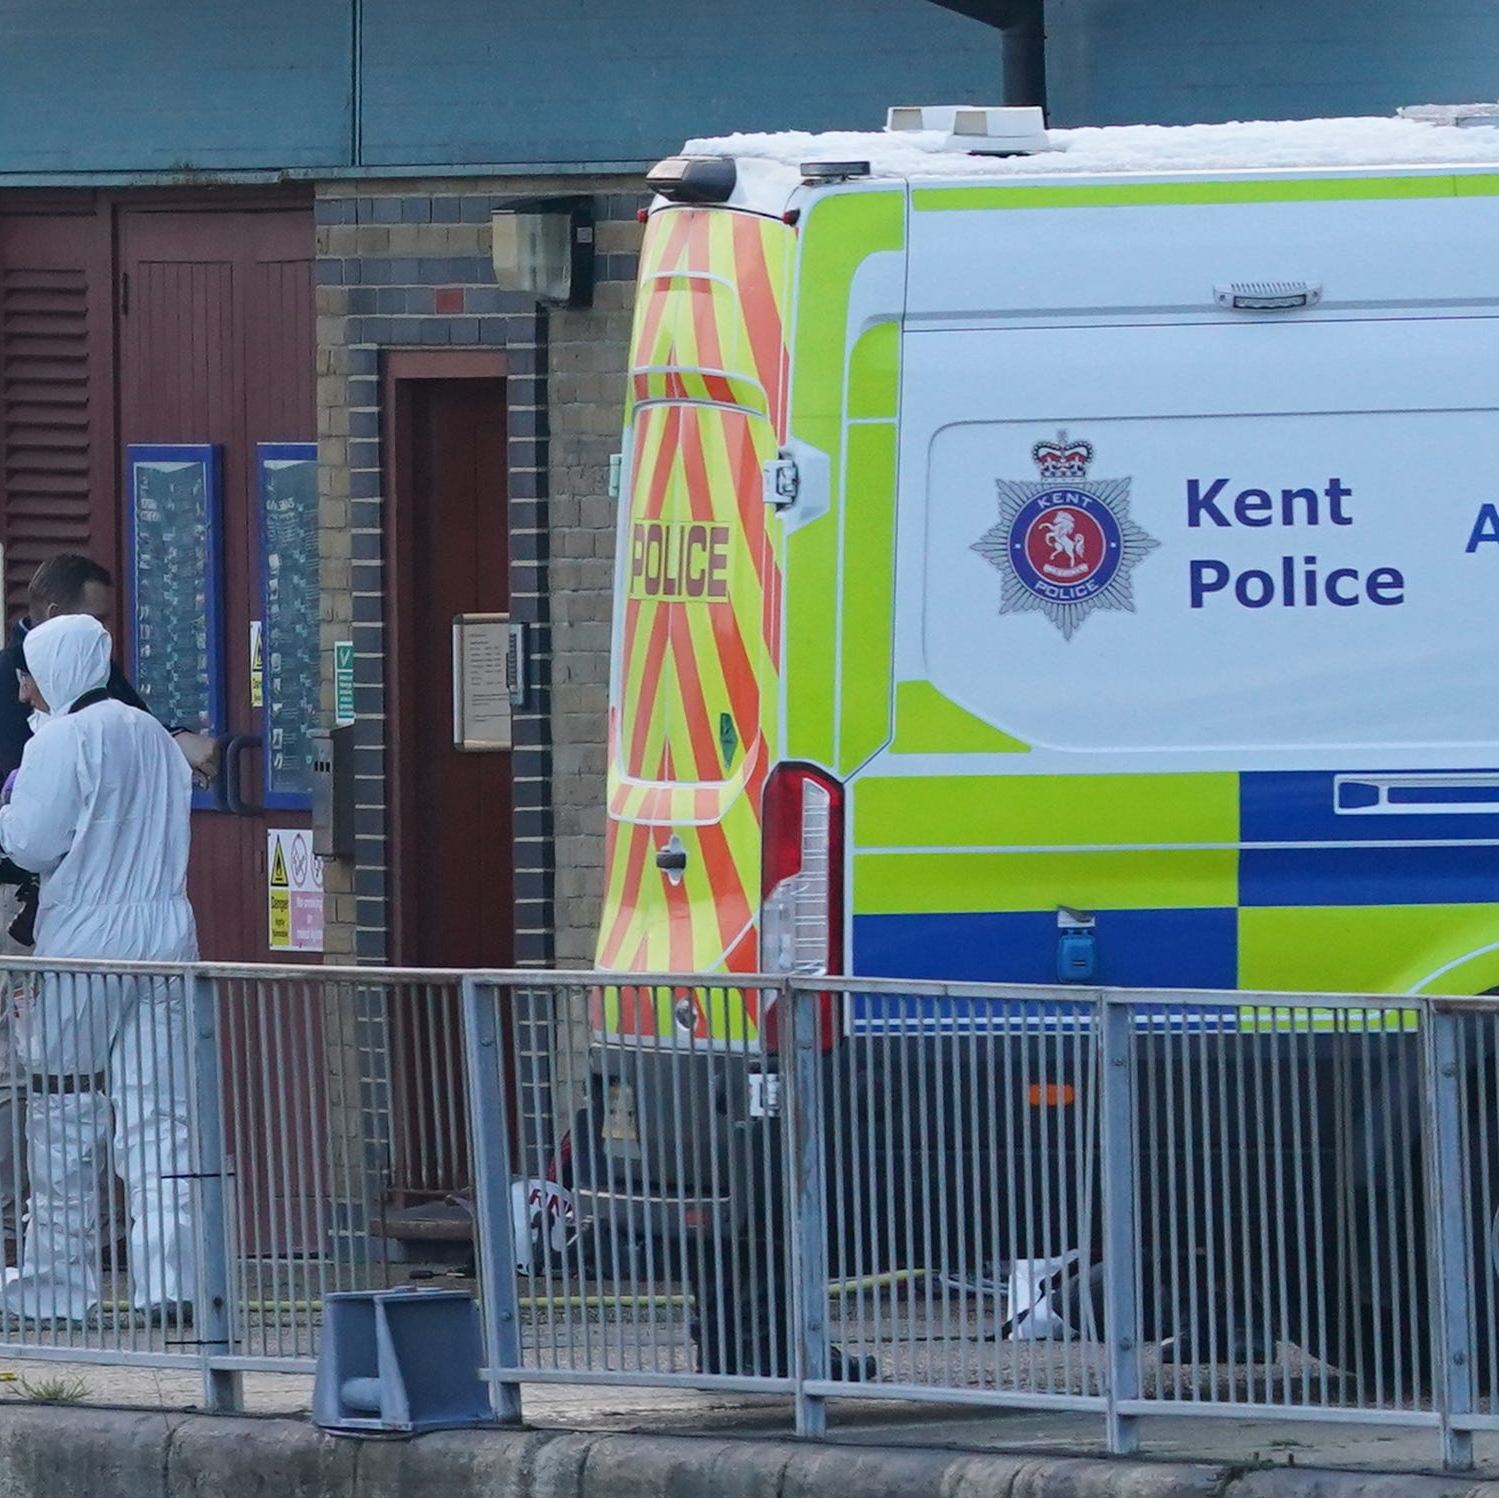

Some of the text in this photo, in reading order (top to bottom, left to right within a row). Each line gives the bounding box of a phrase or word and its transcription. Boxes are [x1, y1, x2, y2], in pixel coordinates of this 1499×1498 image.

[1037, 491, 1094, 509] KENT
[1186, 477, 1354, 528] Kent
[1464, 503, 1499, 553] A
[630, 522, 729, 598] POLICE
[1189, 555, 1406, 609] Police
[1033, 578, 1100, 600] POLICE
